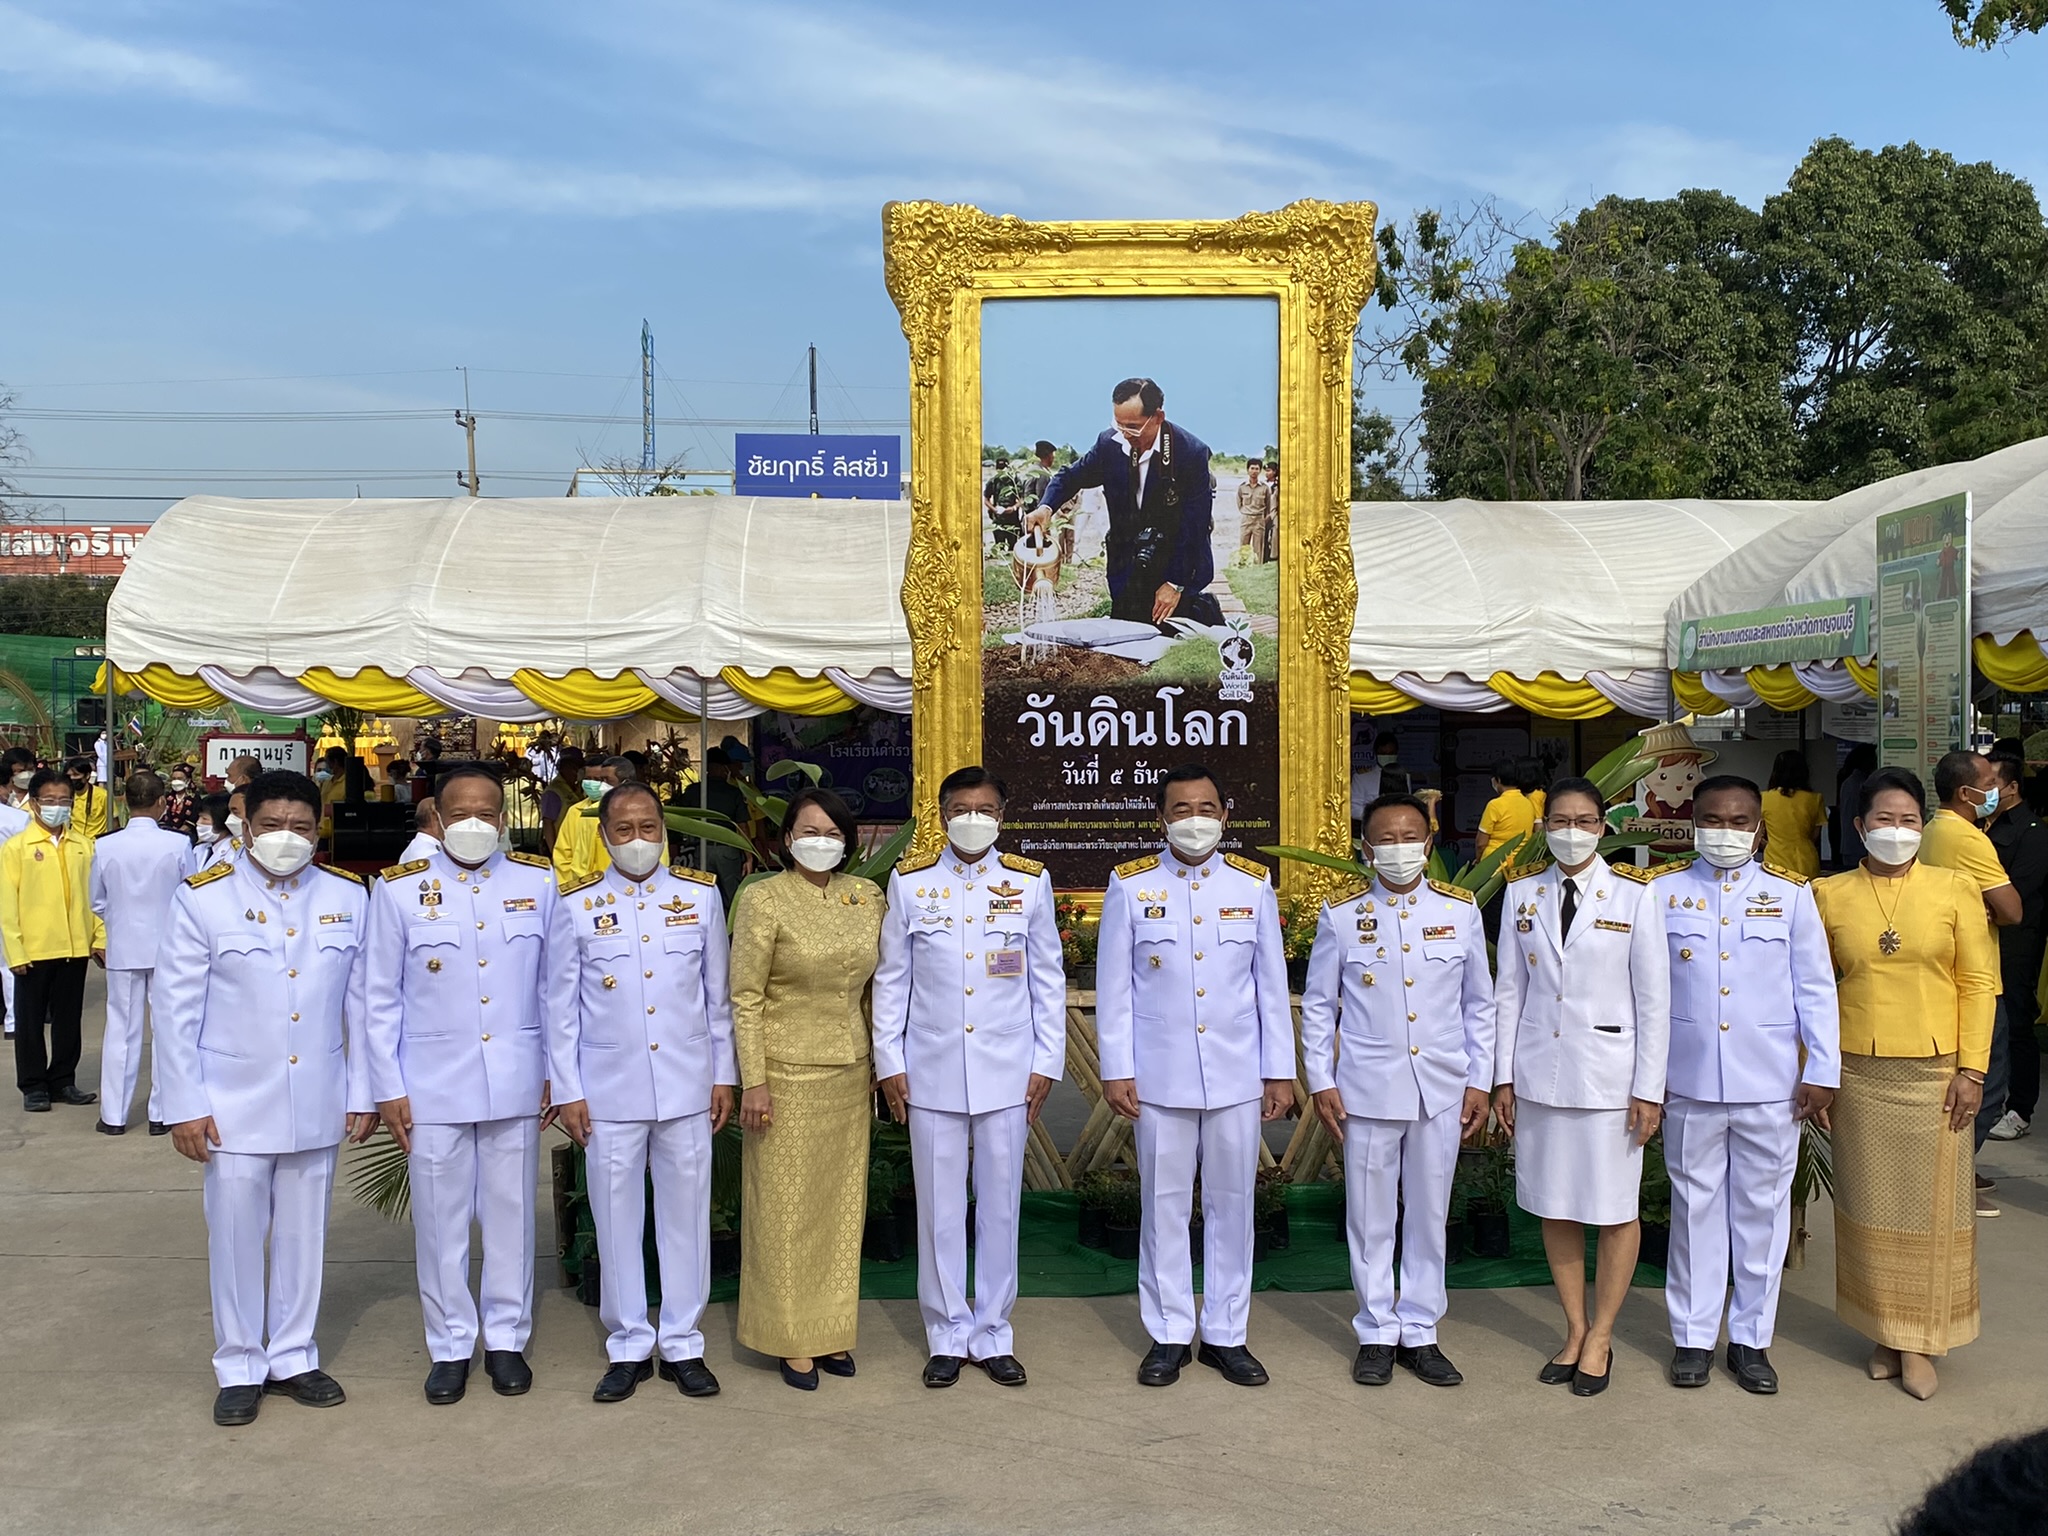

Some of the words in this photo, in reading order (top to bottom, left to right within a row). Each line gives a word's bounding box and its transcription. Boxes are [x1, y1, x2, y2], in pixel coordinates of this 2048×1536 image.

[748, 450, 826, 482] ชัยฤทธิ์
[833, 449, 888, 477] ลีสซิ่ง
[1162, 434, 1170, 466] Canon
[1698, 605, 1855, 648] สำนักงานเกษตรและสหกรณ์จังหวัดกาญจนบุรี
[1220, 690, 1235, 698] Soil
[1236, 690, 1252, 700] Day
[1017, 686, 1247, 747] วันดินโลก
[1061, 754, 1099, 785] วันที่
[1110, 768, 1124, 785] ๕
